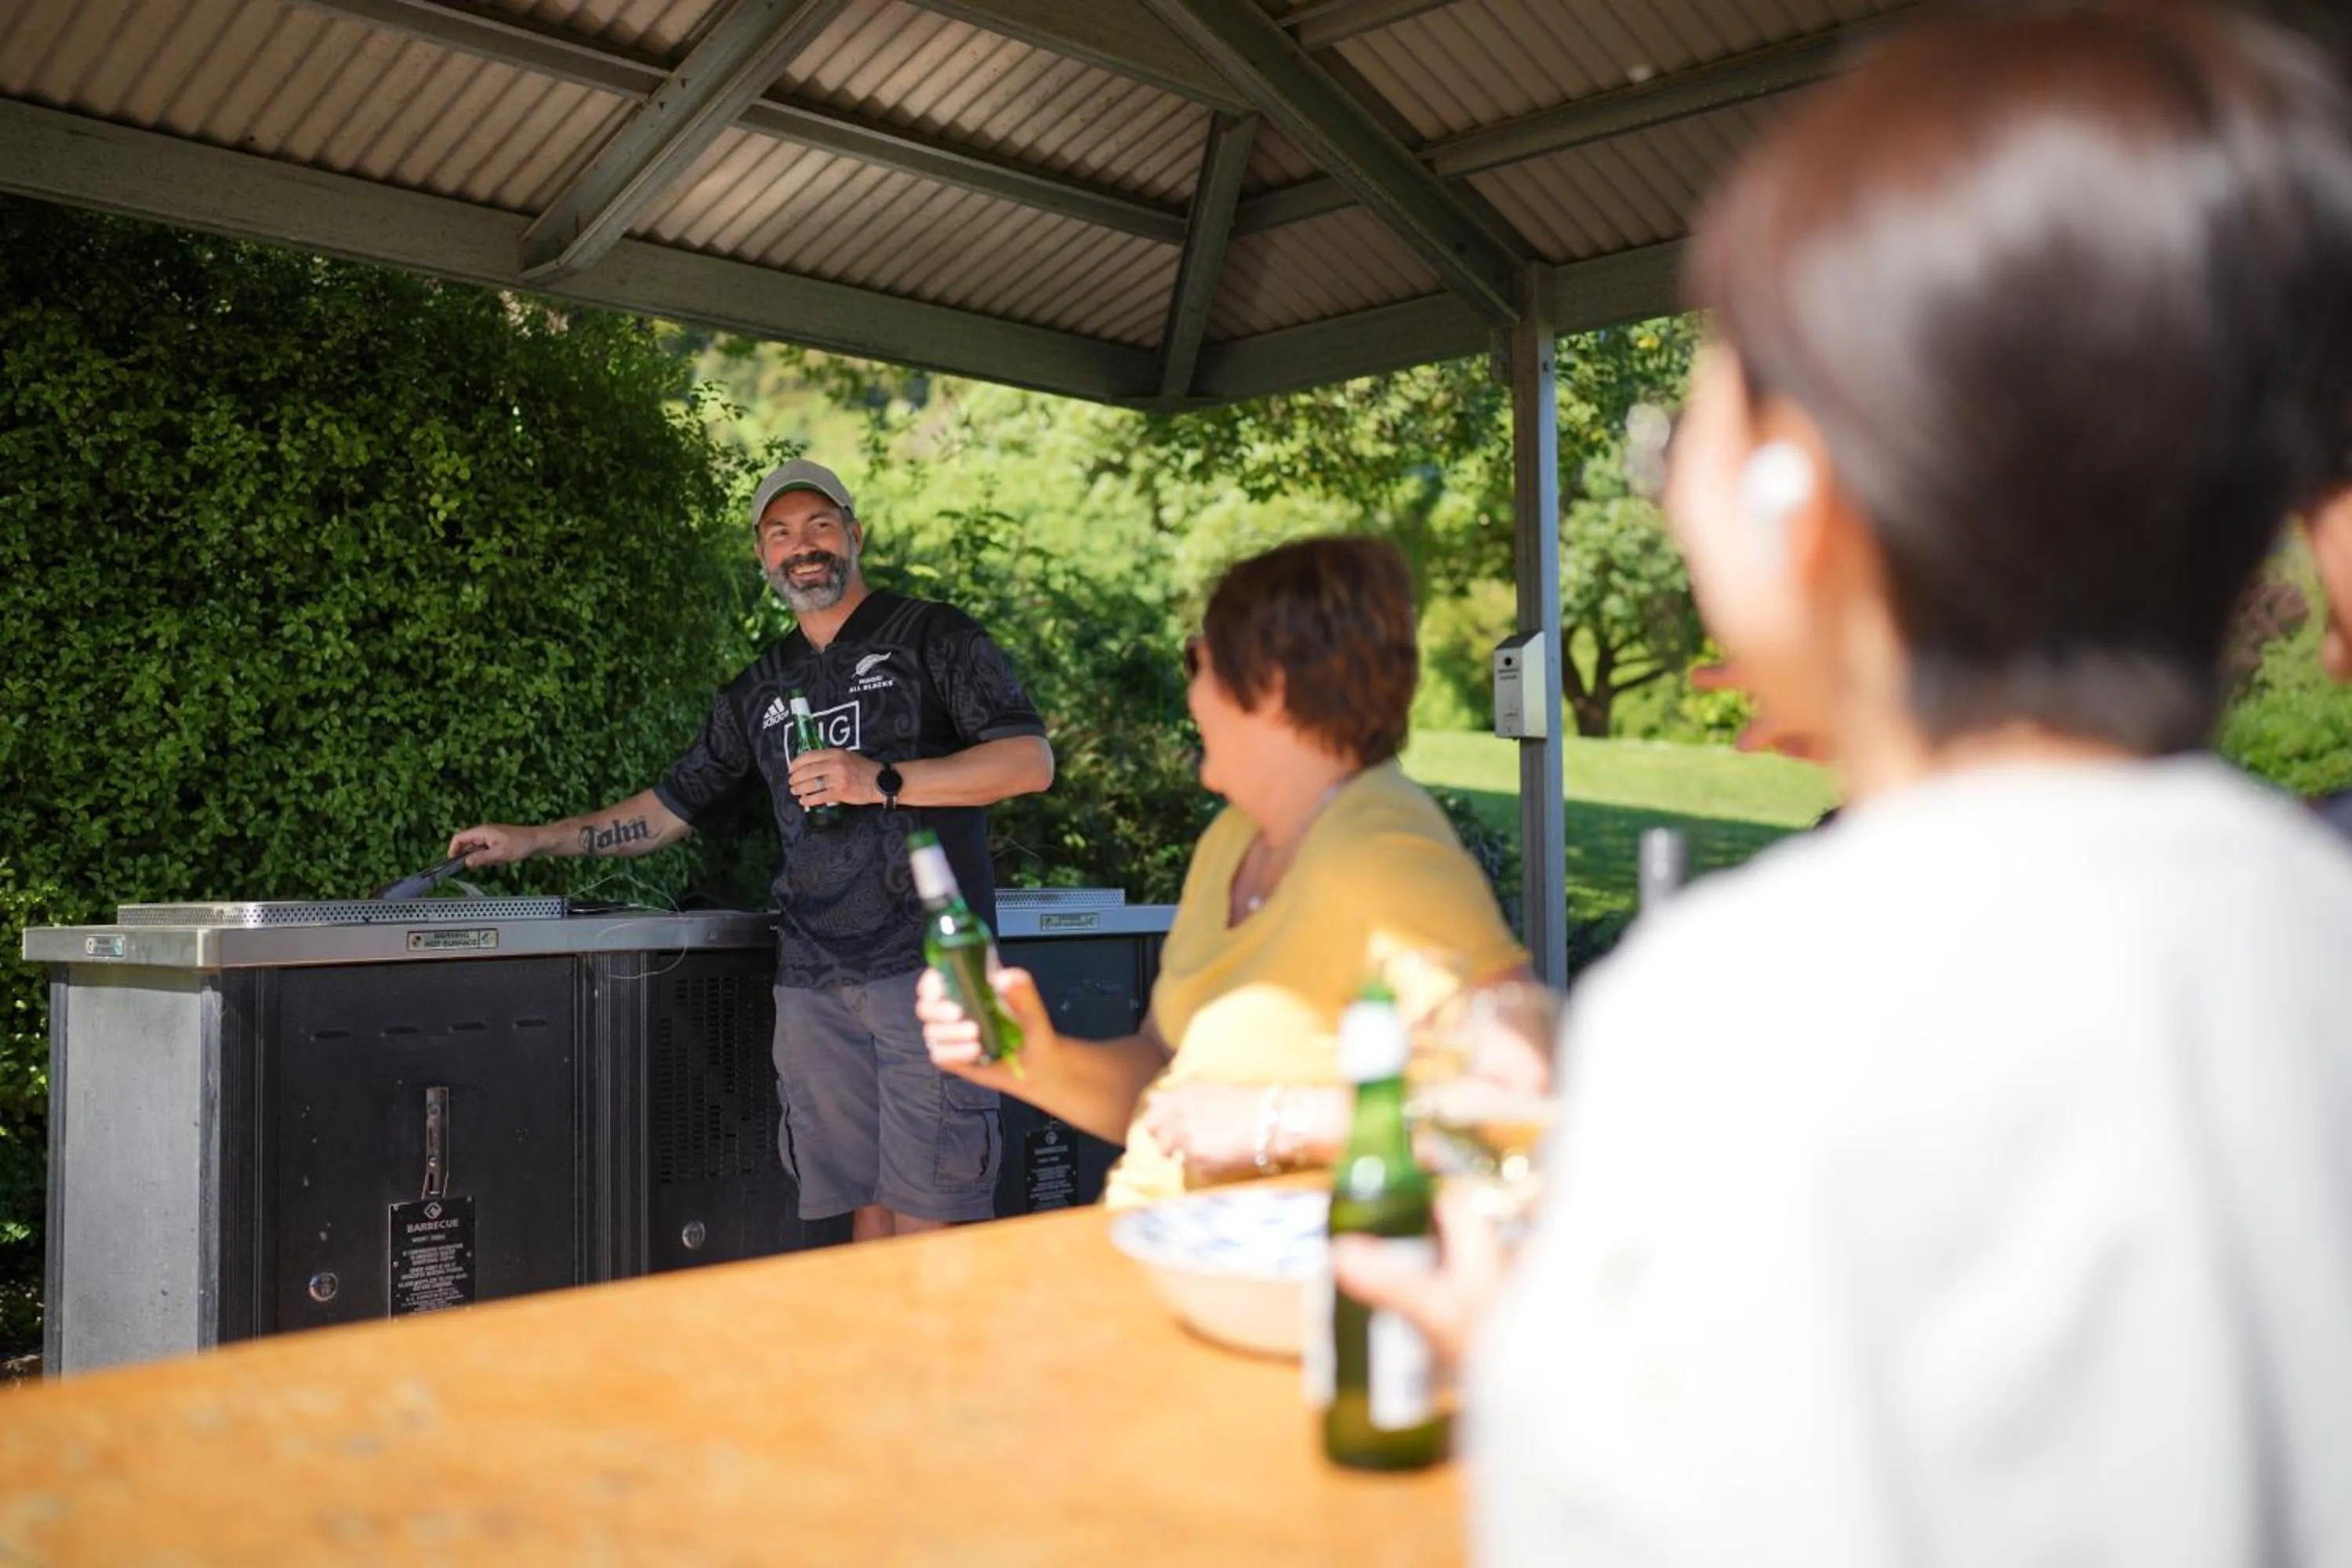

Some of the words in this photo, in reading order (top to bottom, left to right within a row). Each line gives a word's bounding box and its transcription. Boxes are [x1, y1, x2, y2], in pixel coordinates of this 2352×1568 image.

[848, 685, 861, 694] ALL
[863, 680, 893, 691] BLACKS
[763, 709, 789, 730] adidas
[406, 1218, 459, 1234] BARBECUE
